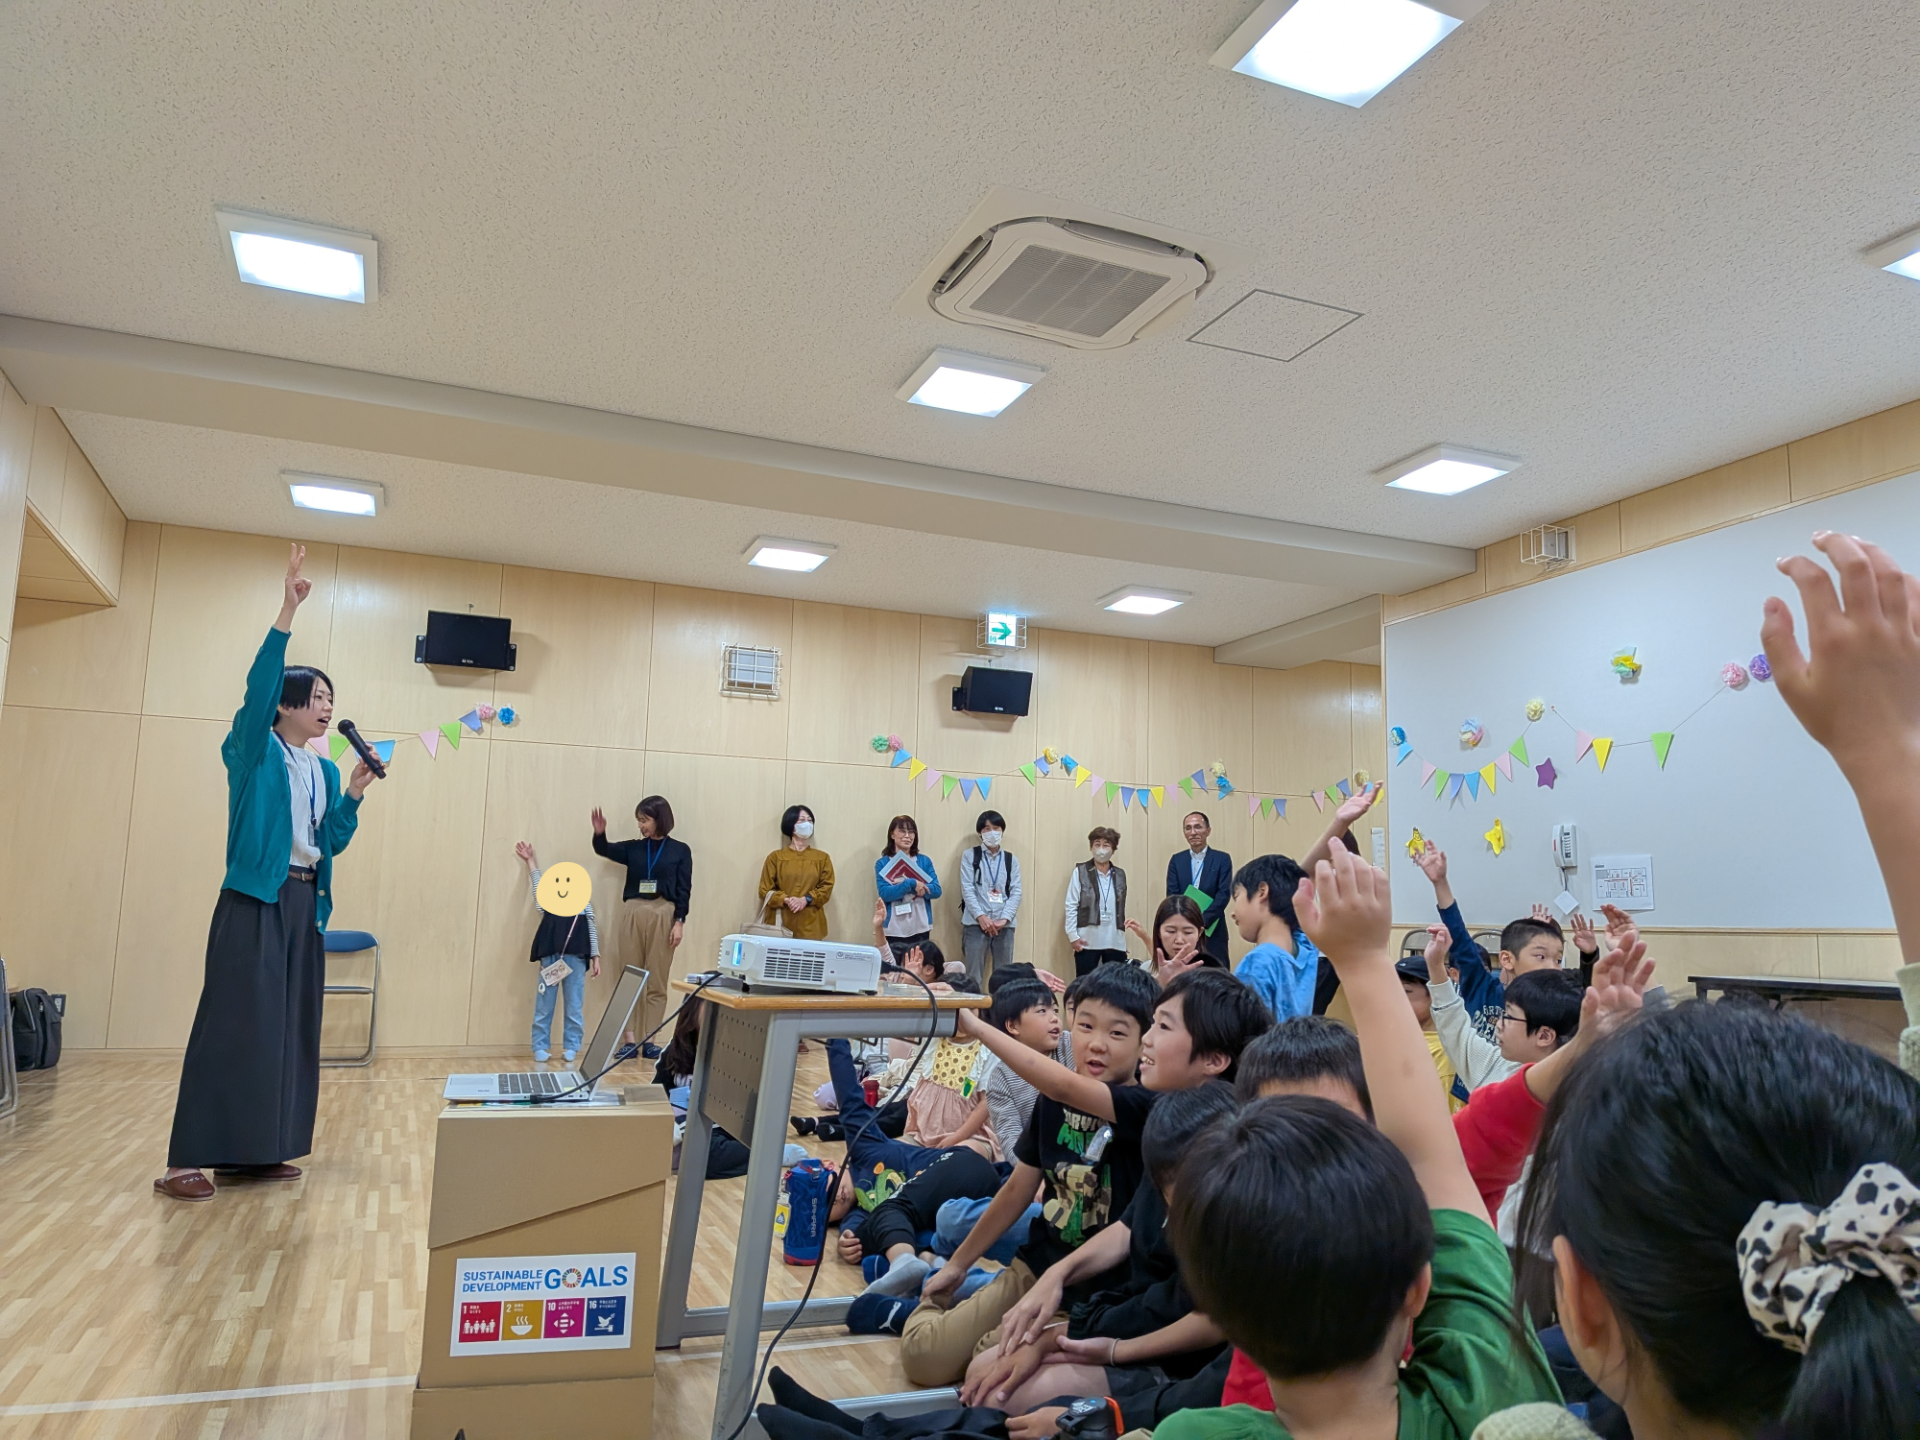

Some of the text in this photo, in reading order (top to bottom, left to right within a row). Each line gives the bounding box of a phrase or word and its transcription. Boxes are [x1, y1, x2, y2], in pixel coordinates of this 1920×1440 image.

[810, 1197, 818, 1238] SAHARA
[463, 1269, 543, 1281] SUSTAINABLE
[544, 1265, 628, 1289] GOALS
[462, 1281, 542, 1293] DEVELOPMENT
[463, 1305, 468, 1314] 1
[505, 1304, 512, 1313] 2
[547, 1302, 556, 1311] 10
[588, 1300, 597, 1309] 16
